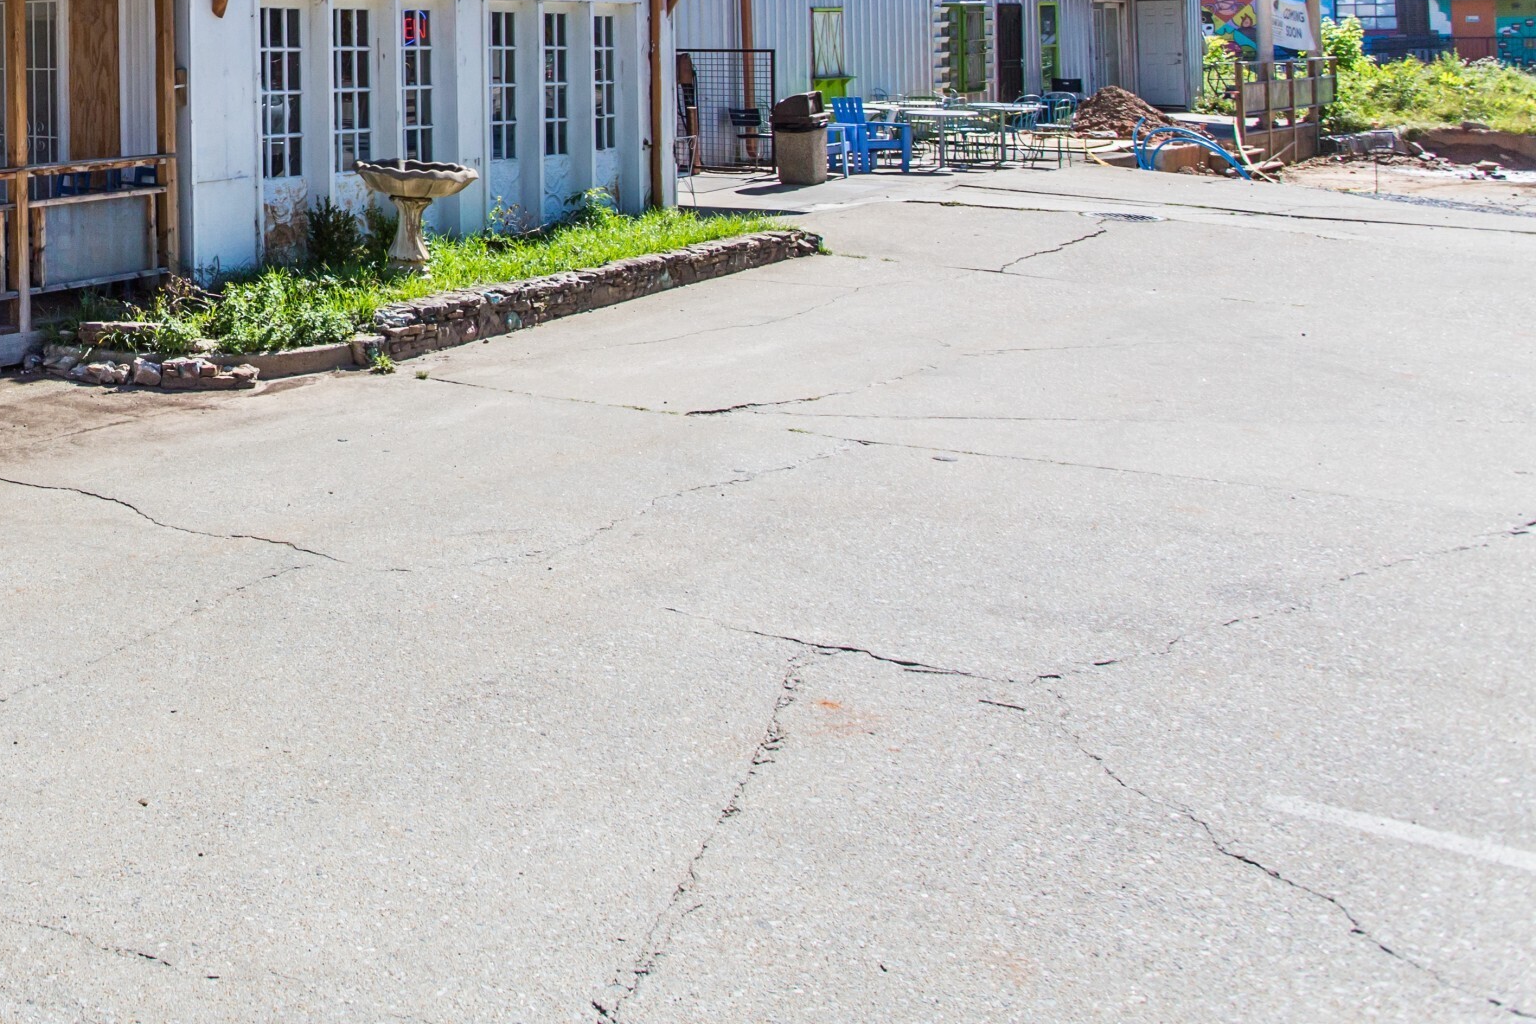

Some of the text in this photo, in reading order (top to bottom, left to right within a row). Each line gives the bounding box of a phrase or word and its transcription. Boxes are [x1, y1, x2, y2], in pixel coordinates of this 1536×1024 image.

[1282, 7, 1305, 23] COMING
[403, 18, 426, 40] EN
[1285, 25, 1303, 39] SOON
